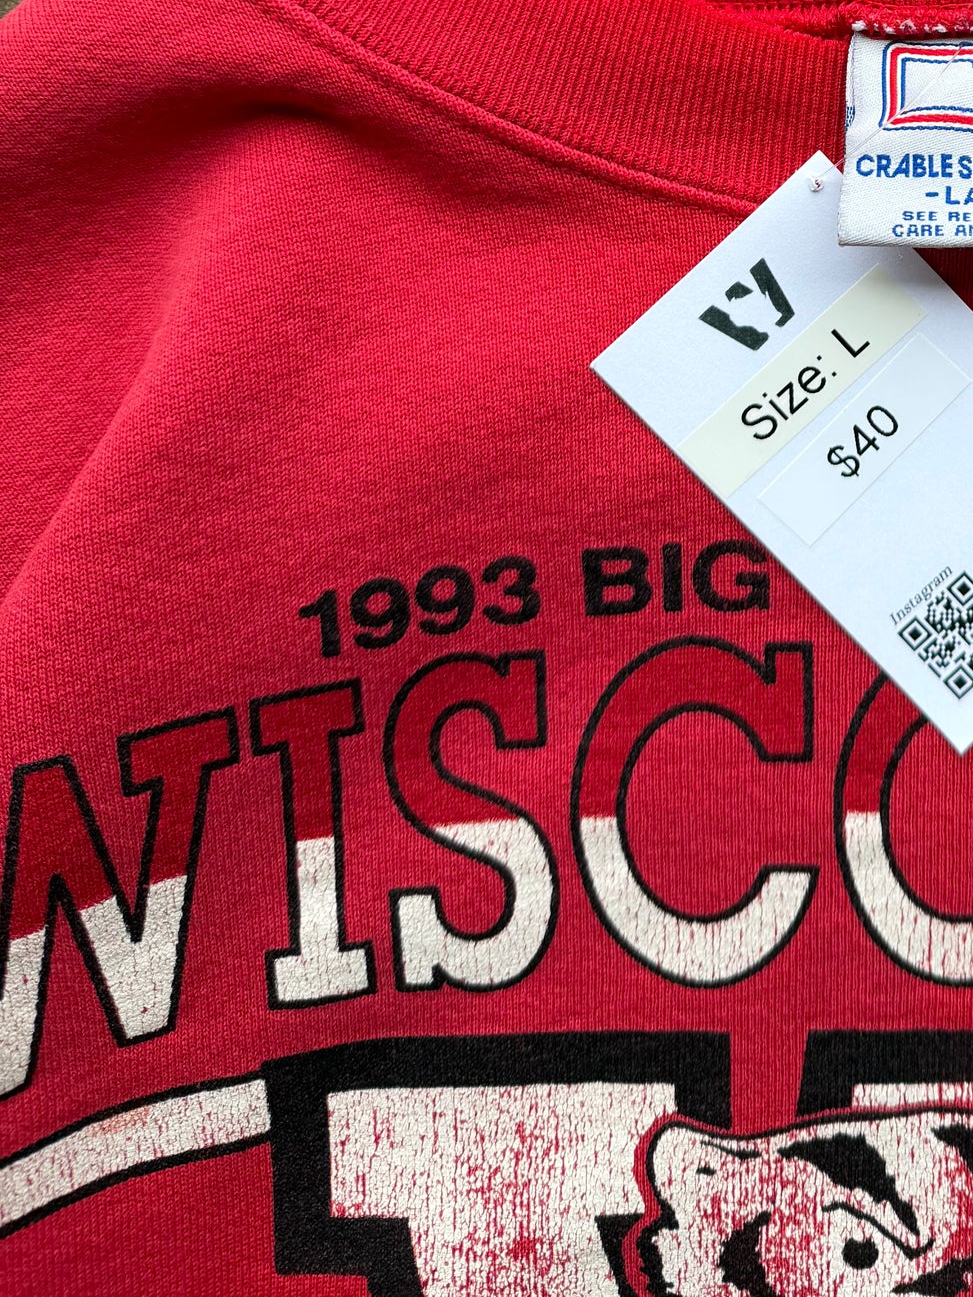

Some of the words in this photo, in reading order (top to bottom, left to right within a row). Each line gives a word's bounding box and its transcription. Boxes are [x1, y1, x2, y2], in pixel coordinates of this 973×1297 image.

[856, 153, 953, 178] CRABLE
[892, 224, 945, 238] CARE
[902, 210, 938, 222] SEE
[741, 355, 837, 440] Size:
[831, 328, 870, 358] L
[827, 405, 898, 478] $40
[299, 556, 541, 658] 1993
[581, 540, 770, 617] BIG
[889, 566, 953, 626] Instagram
